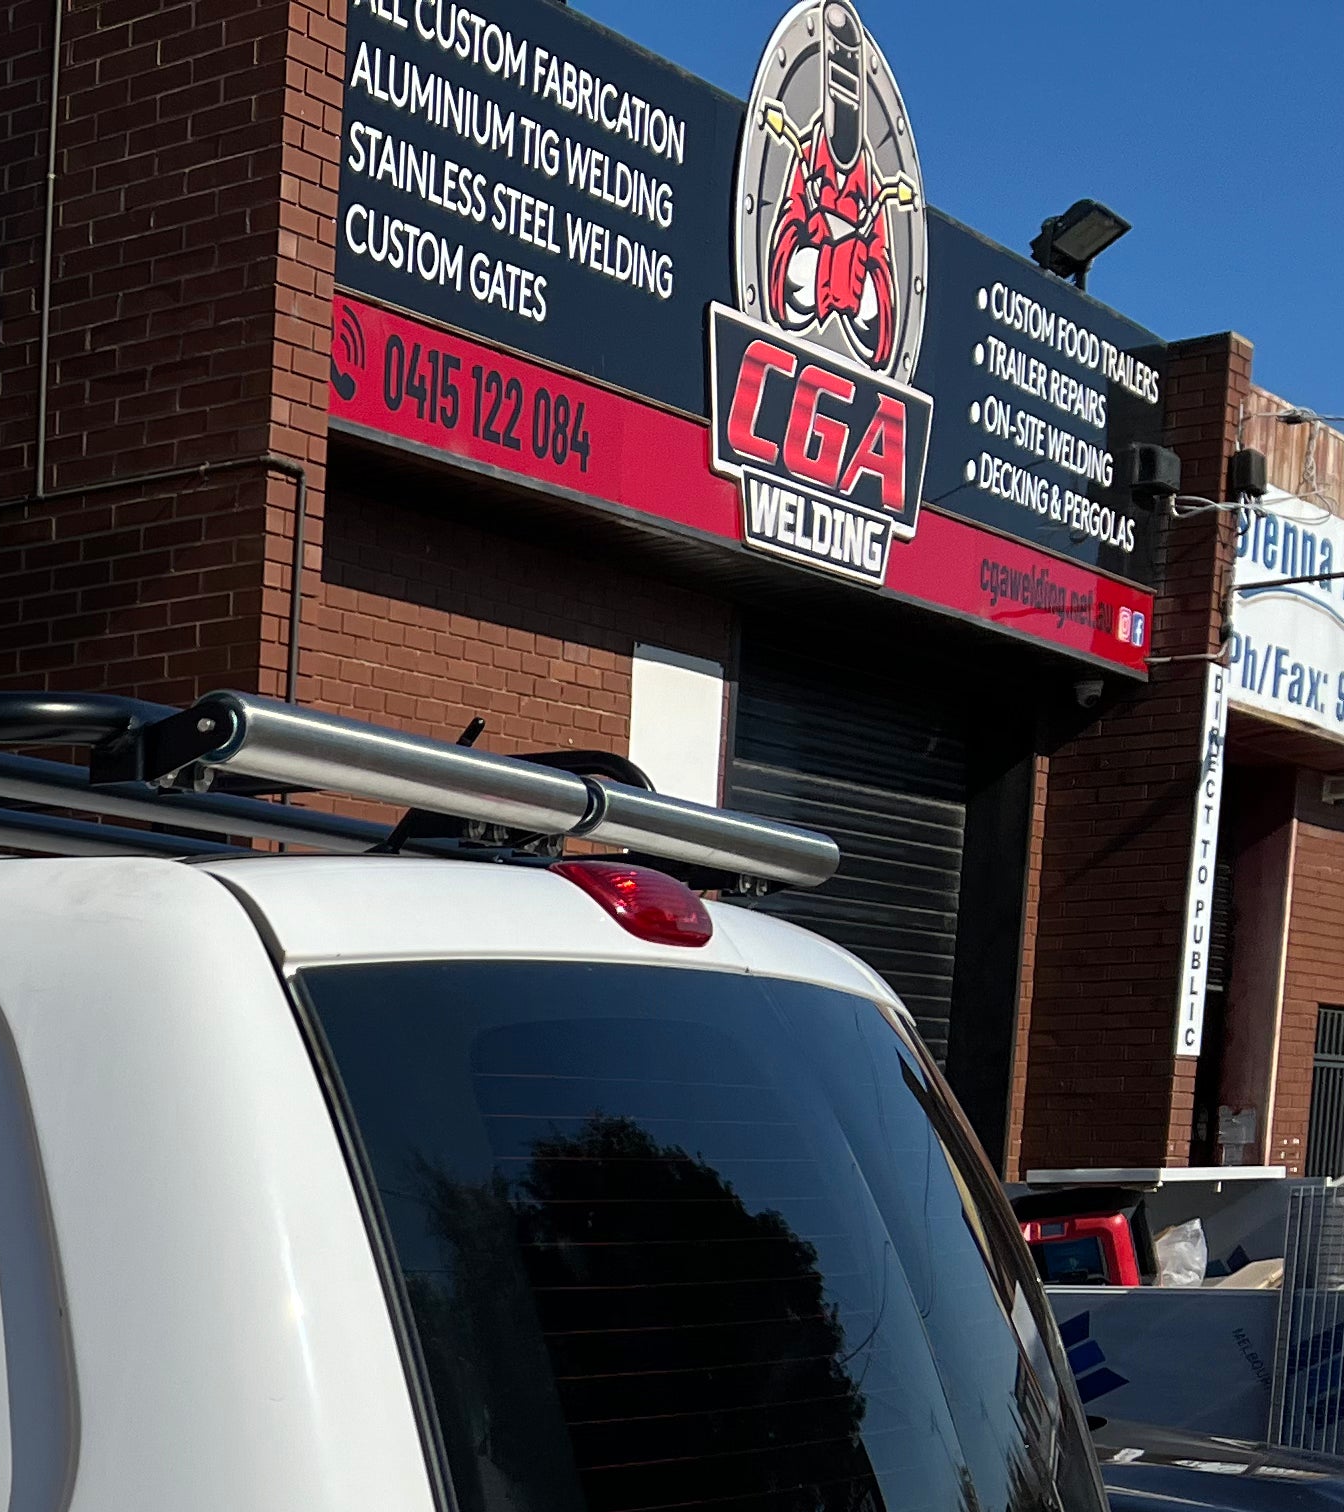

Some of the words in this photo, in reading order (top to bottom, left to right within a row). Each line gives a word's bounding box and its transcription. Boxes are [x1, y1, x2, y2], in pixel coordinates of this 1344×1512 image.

[351, 42, 515, 158] ALUMINIUM
[521, 122, 560, 176] TIG
[566, 137, 674, 229] WELDING
[415, 0, 527, 86] CUSTOM
[533, 47, 686, 164] FABRICATION
[345, 204, 464, 292] CUSTOM
[470, 253, 548, 322] GATES
[348, 121, 487, 223] STAINLESS
[492, 182, 561, 255] STEEL
[566, 212, 674, 300] WELDING
[383, 334, 461, 430] 0415
[472, 366, 523, 452] 122
[532, 387, 591, 473] 084
[987, 335, 1048, 401] TRAILER
[1050, 368, 1107, 429] REPAIRS
[990, 282, 1056, 347] CUSTOM
[1057, 316, 1100, 370] FOOD
[1101, 340, 1160, 405] TRAILERS
[727, 339, 907, 512] CGA
[983, 395, 1045, 456] ON-SITE
[1046, 422, 1114, 488] WELDING
[749, 479, 884, 571] WELDING
[979, 451, 1049, 515] DECKING
[1050, 485, 1062, 521] &
[1063, 495, 1135, 553] PERGOLAS
[980, 558, 1113, 634] cgawelding.net.au
[1198, 839, 1212, 885] TO
[1184, 900, 1205, 1047] PUBLIC
